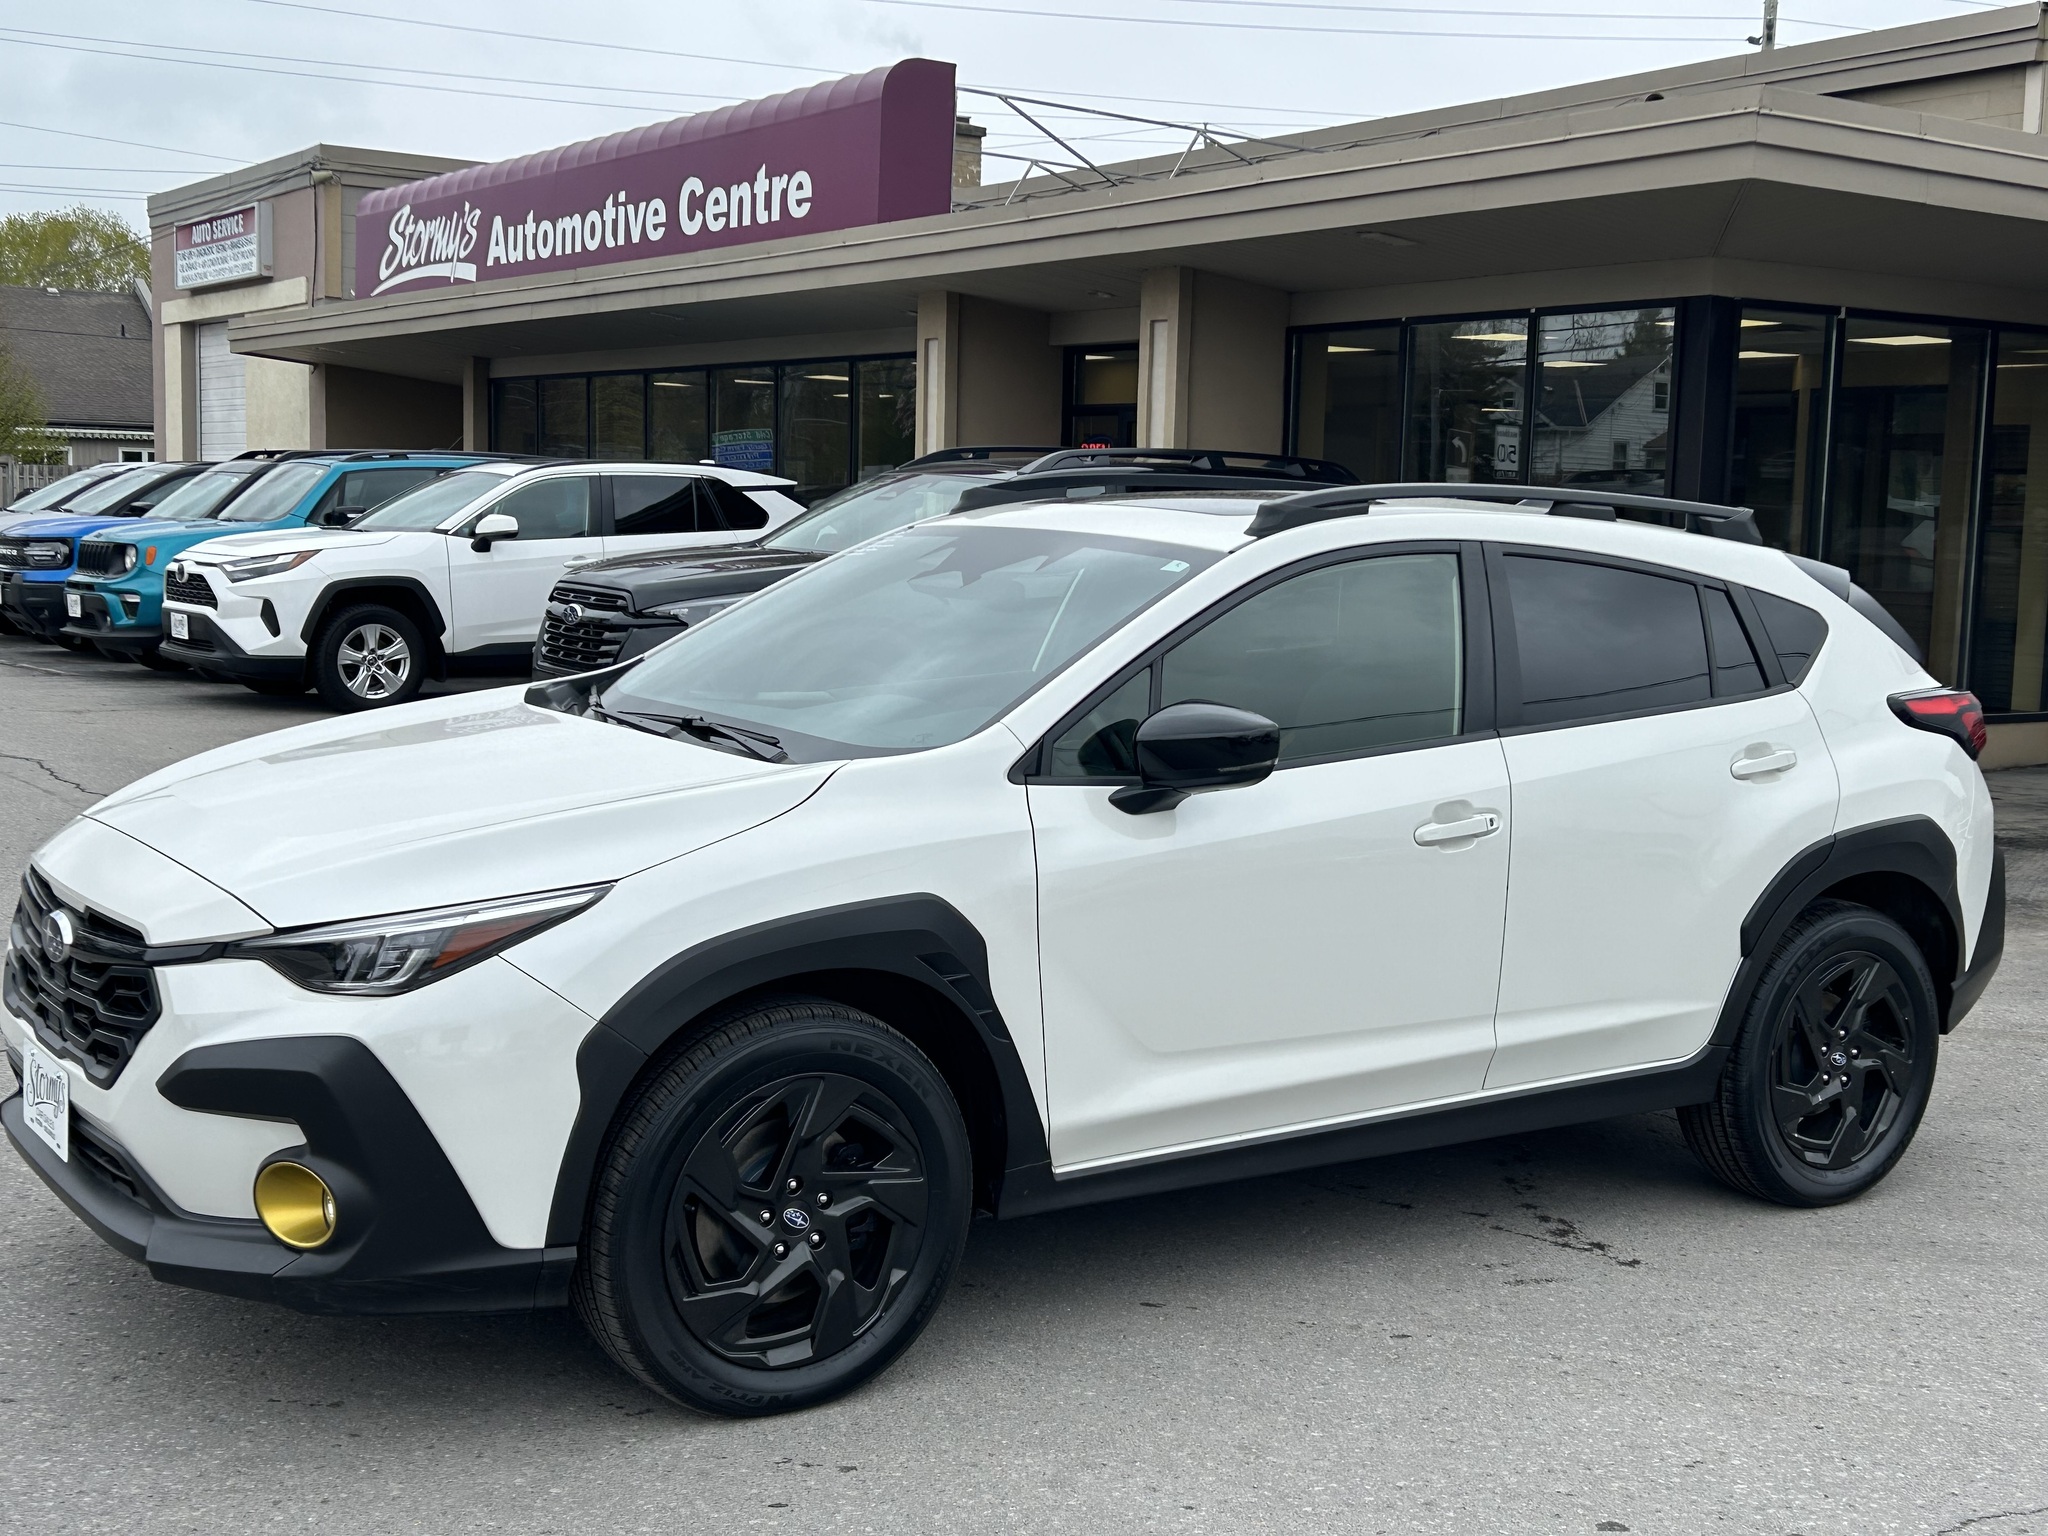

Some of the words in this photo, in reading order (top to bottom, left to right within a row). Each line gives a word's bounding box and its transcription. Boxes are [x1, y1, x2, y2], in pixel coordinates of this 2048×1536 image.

[191, 221, 211, 244] AUTO
[213, 213, 244, 240] SERVICE
[379, 201, 481, 283] Stormy's
[486, 190, 667, 267] Automotive
[678, 162, 813, 237] Centre
[830, 1038, 932, 1101] NEXEN
